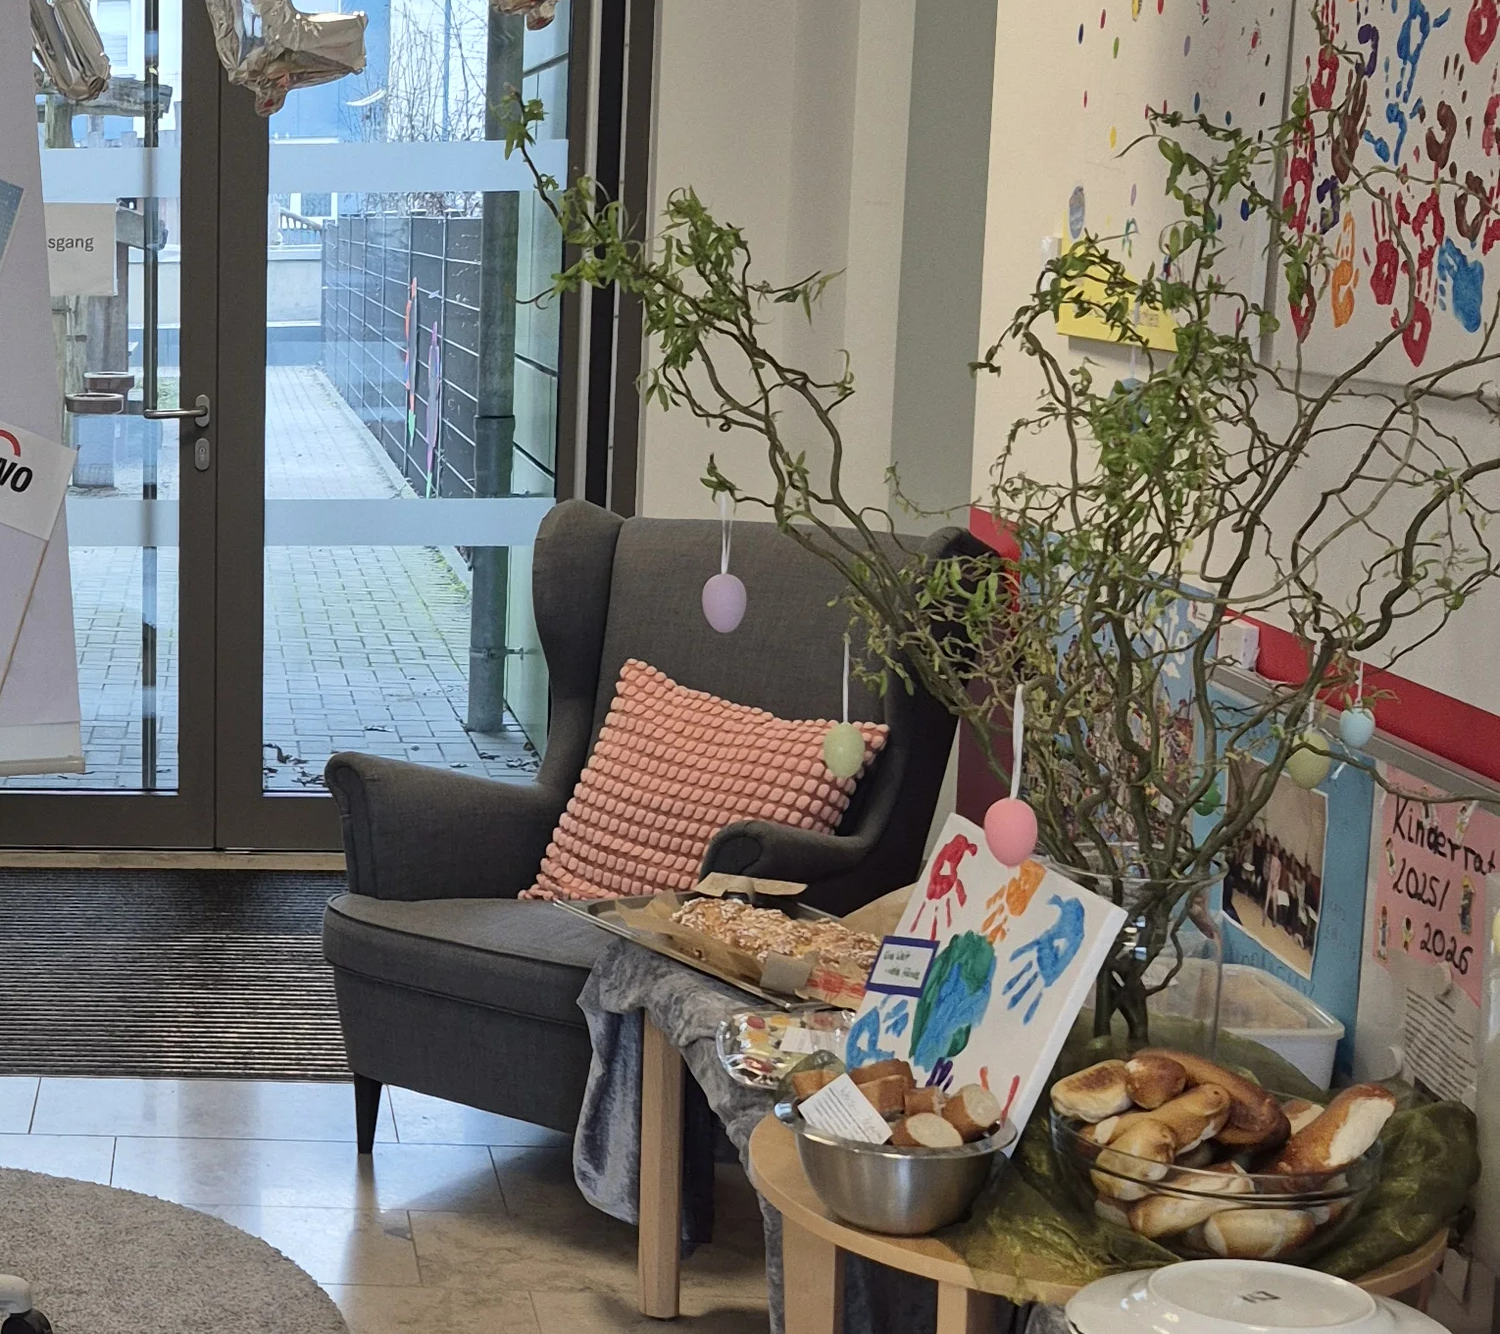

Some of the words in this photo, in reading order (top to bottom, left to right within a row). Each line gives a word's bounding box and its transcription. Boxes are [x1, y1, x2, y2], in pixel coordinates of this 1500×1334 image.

[48, 237, 95, 252] sgang
[1392, 795, 1497, 877] Kinderrat
[1420, 922, 1474, 975] 2026
